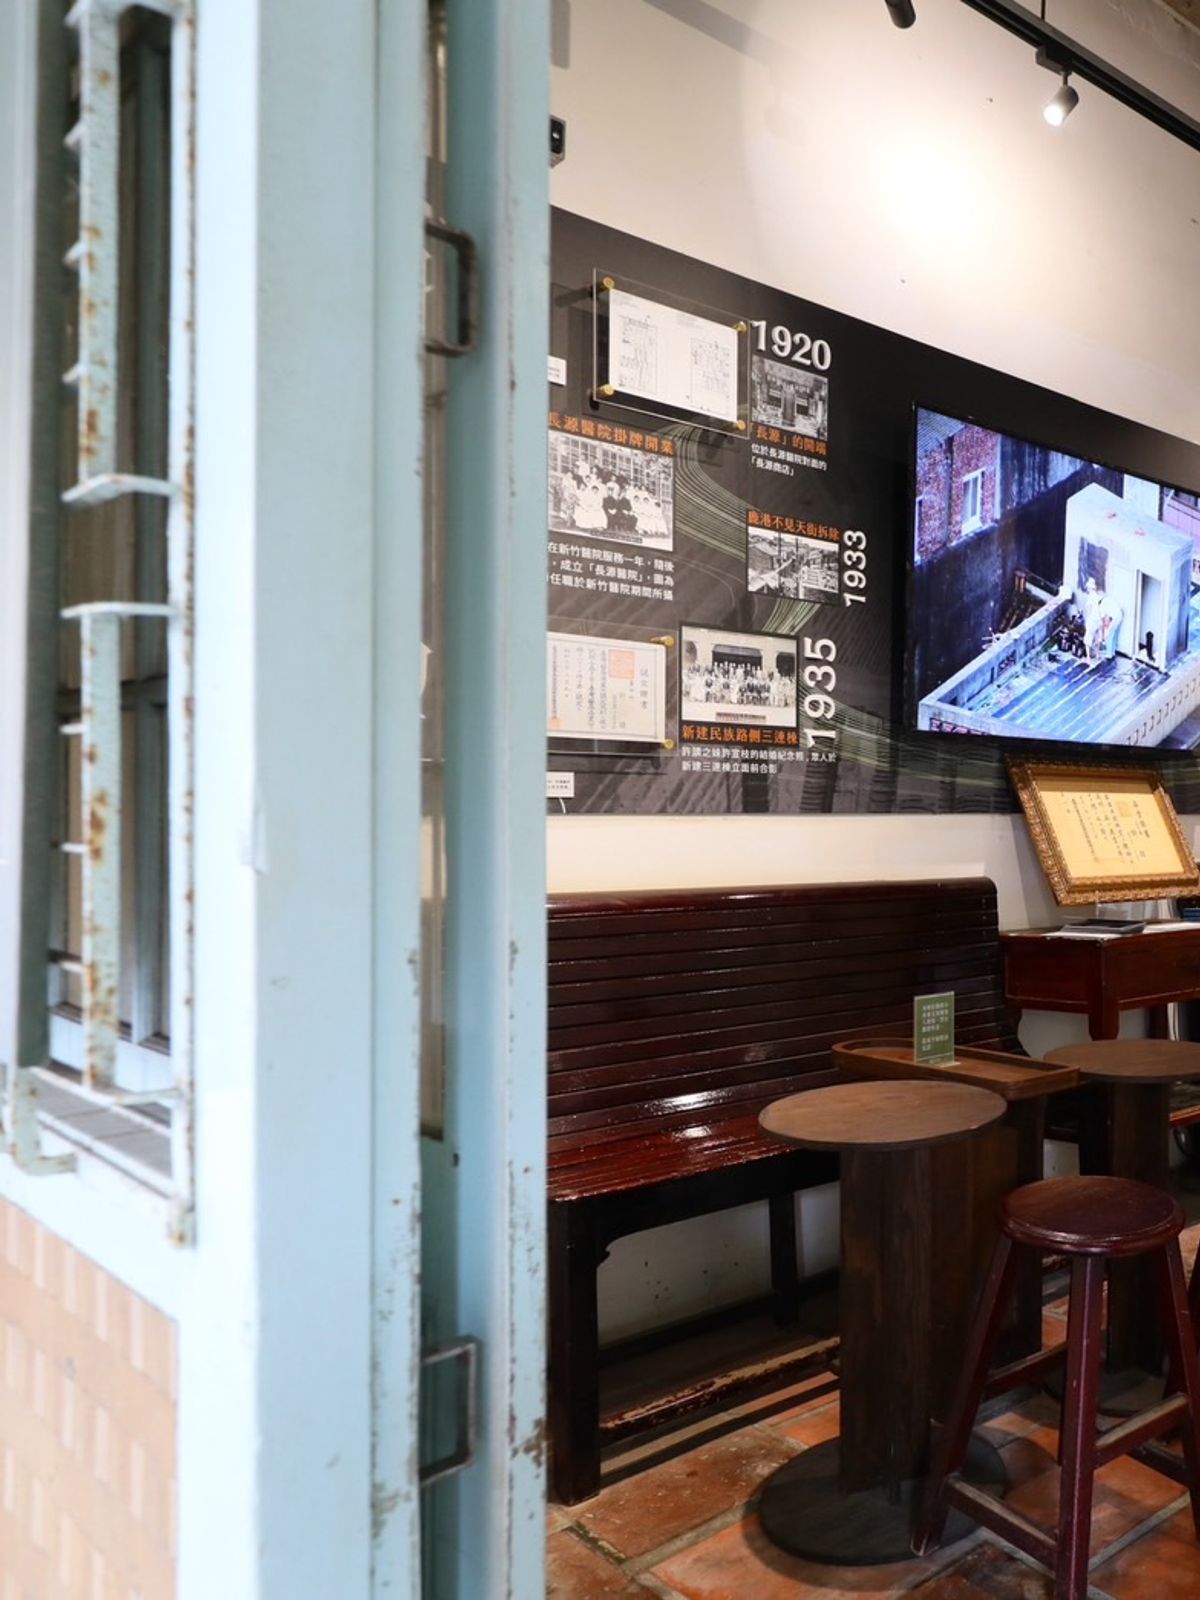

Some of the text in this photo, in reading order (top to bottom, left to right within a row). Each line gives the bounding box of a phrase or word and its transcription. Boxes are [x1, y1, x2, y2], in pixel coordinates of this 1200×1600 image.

[750, 320, 831, 371] 1920
[748, 510, 840, 541] 鹿港不見天街拆除
[843, 530, 867, 608] 1933
[803, 636, 837, 748] 1935
